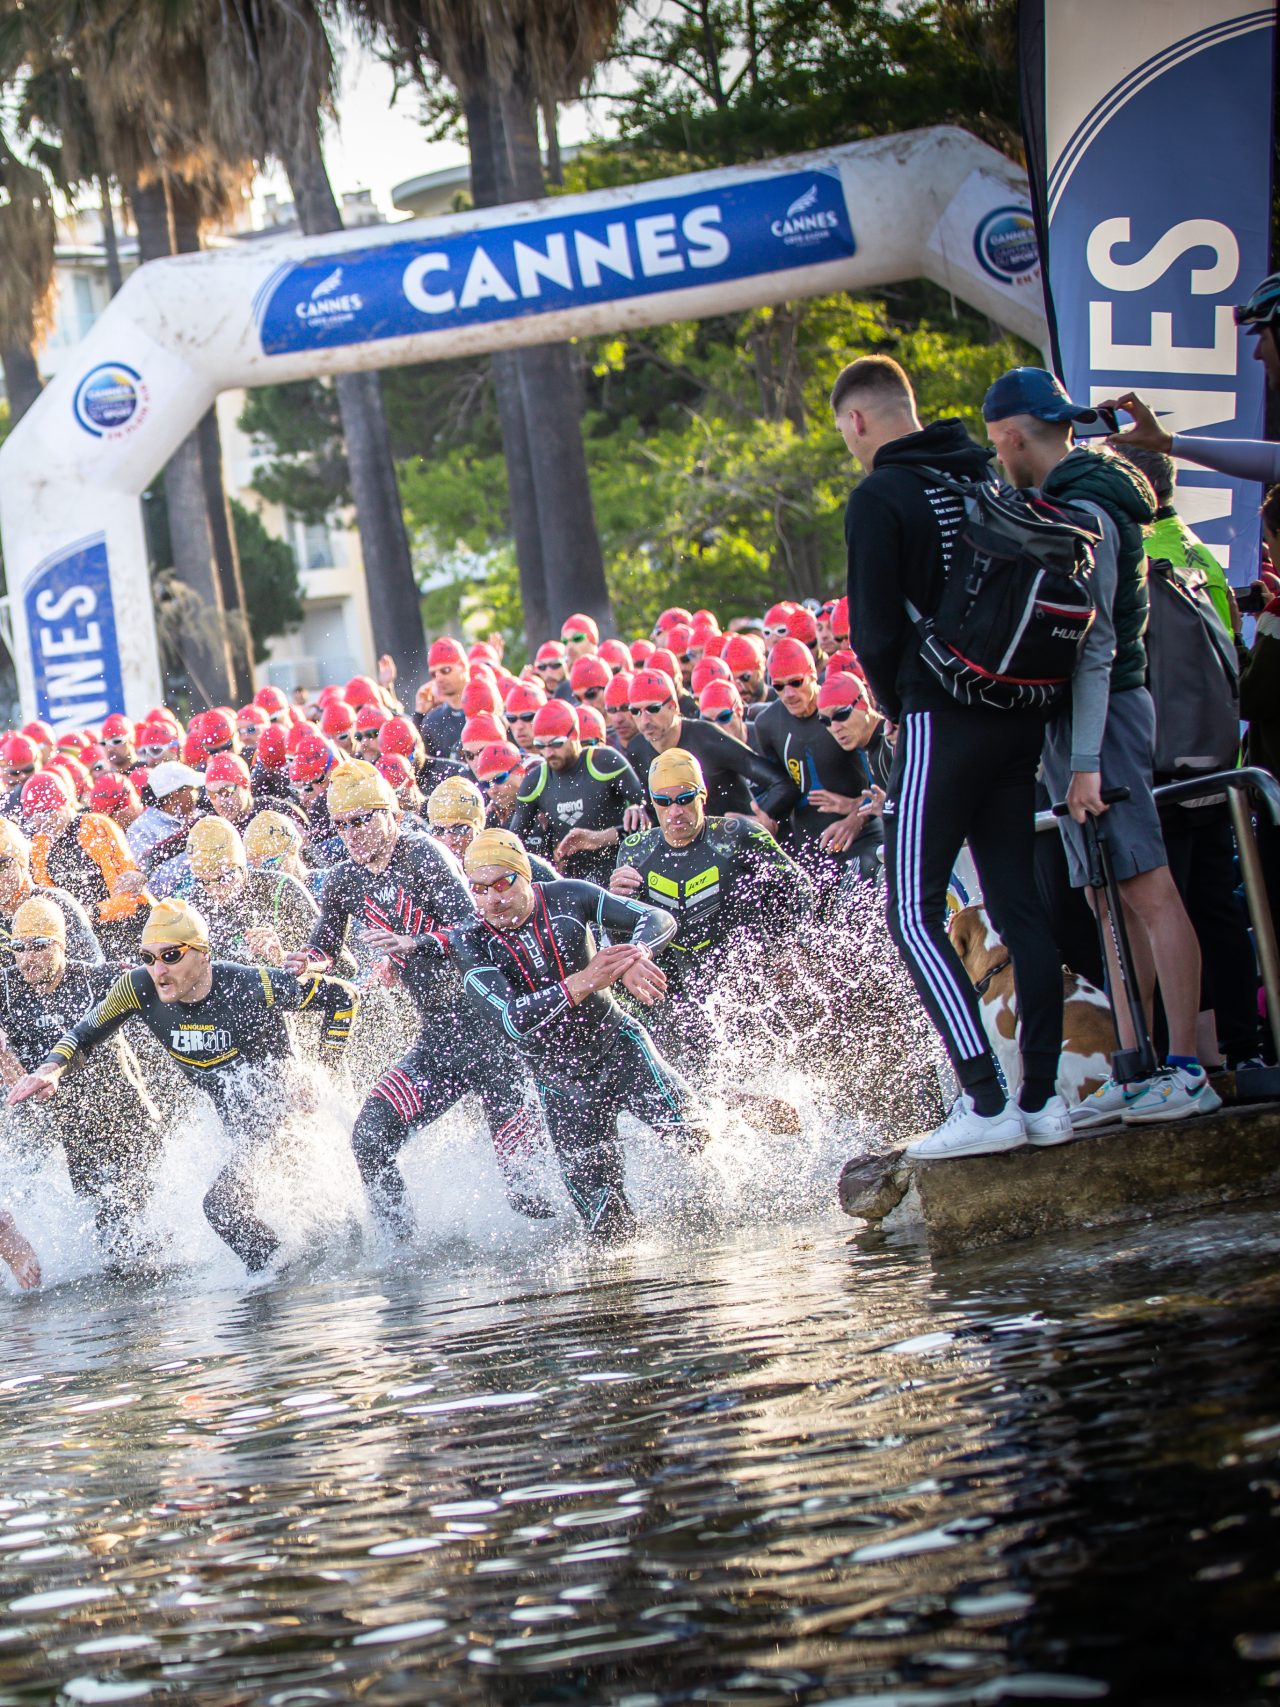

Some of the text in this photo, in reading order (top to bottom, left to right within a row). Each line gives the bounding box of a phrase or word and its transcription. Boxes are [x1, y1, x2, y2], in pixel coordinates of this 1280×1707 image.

[771, 210, 839, 237] CANNES
[402, 205, 731, 315] CANNES
[295, 293, 363, 319] CANNES
[557, 799, 583, 813] arena
